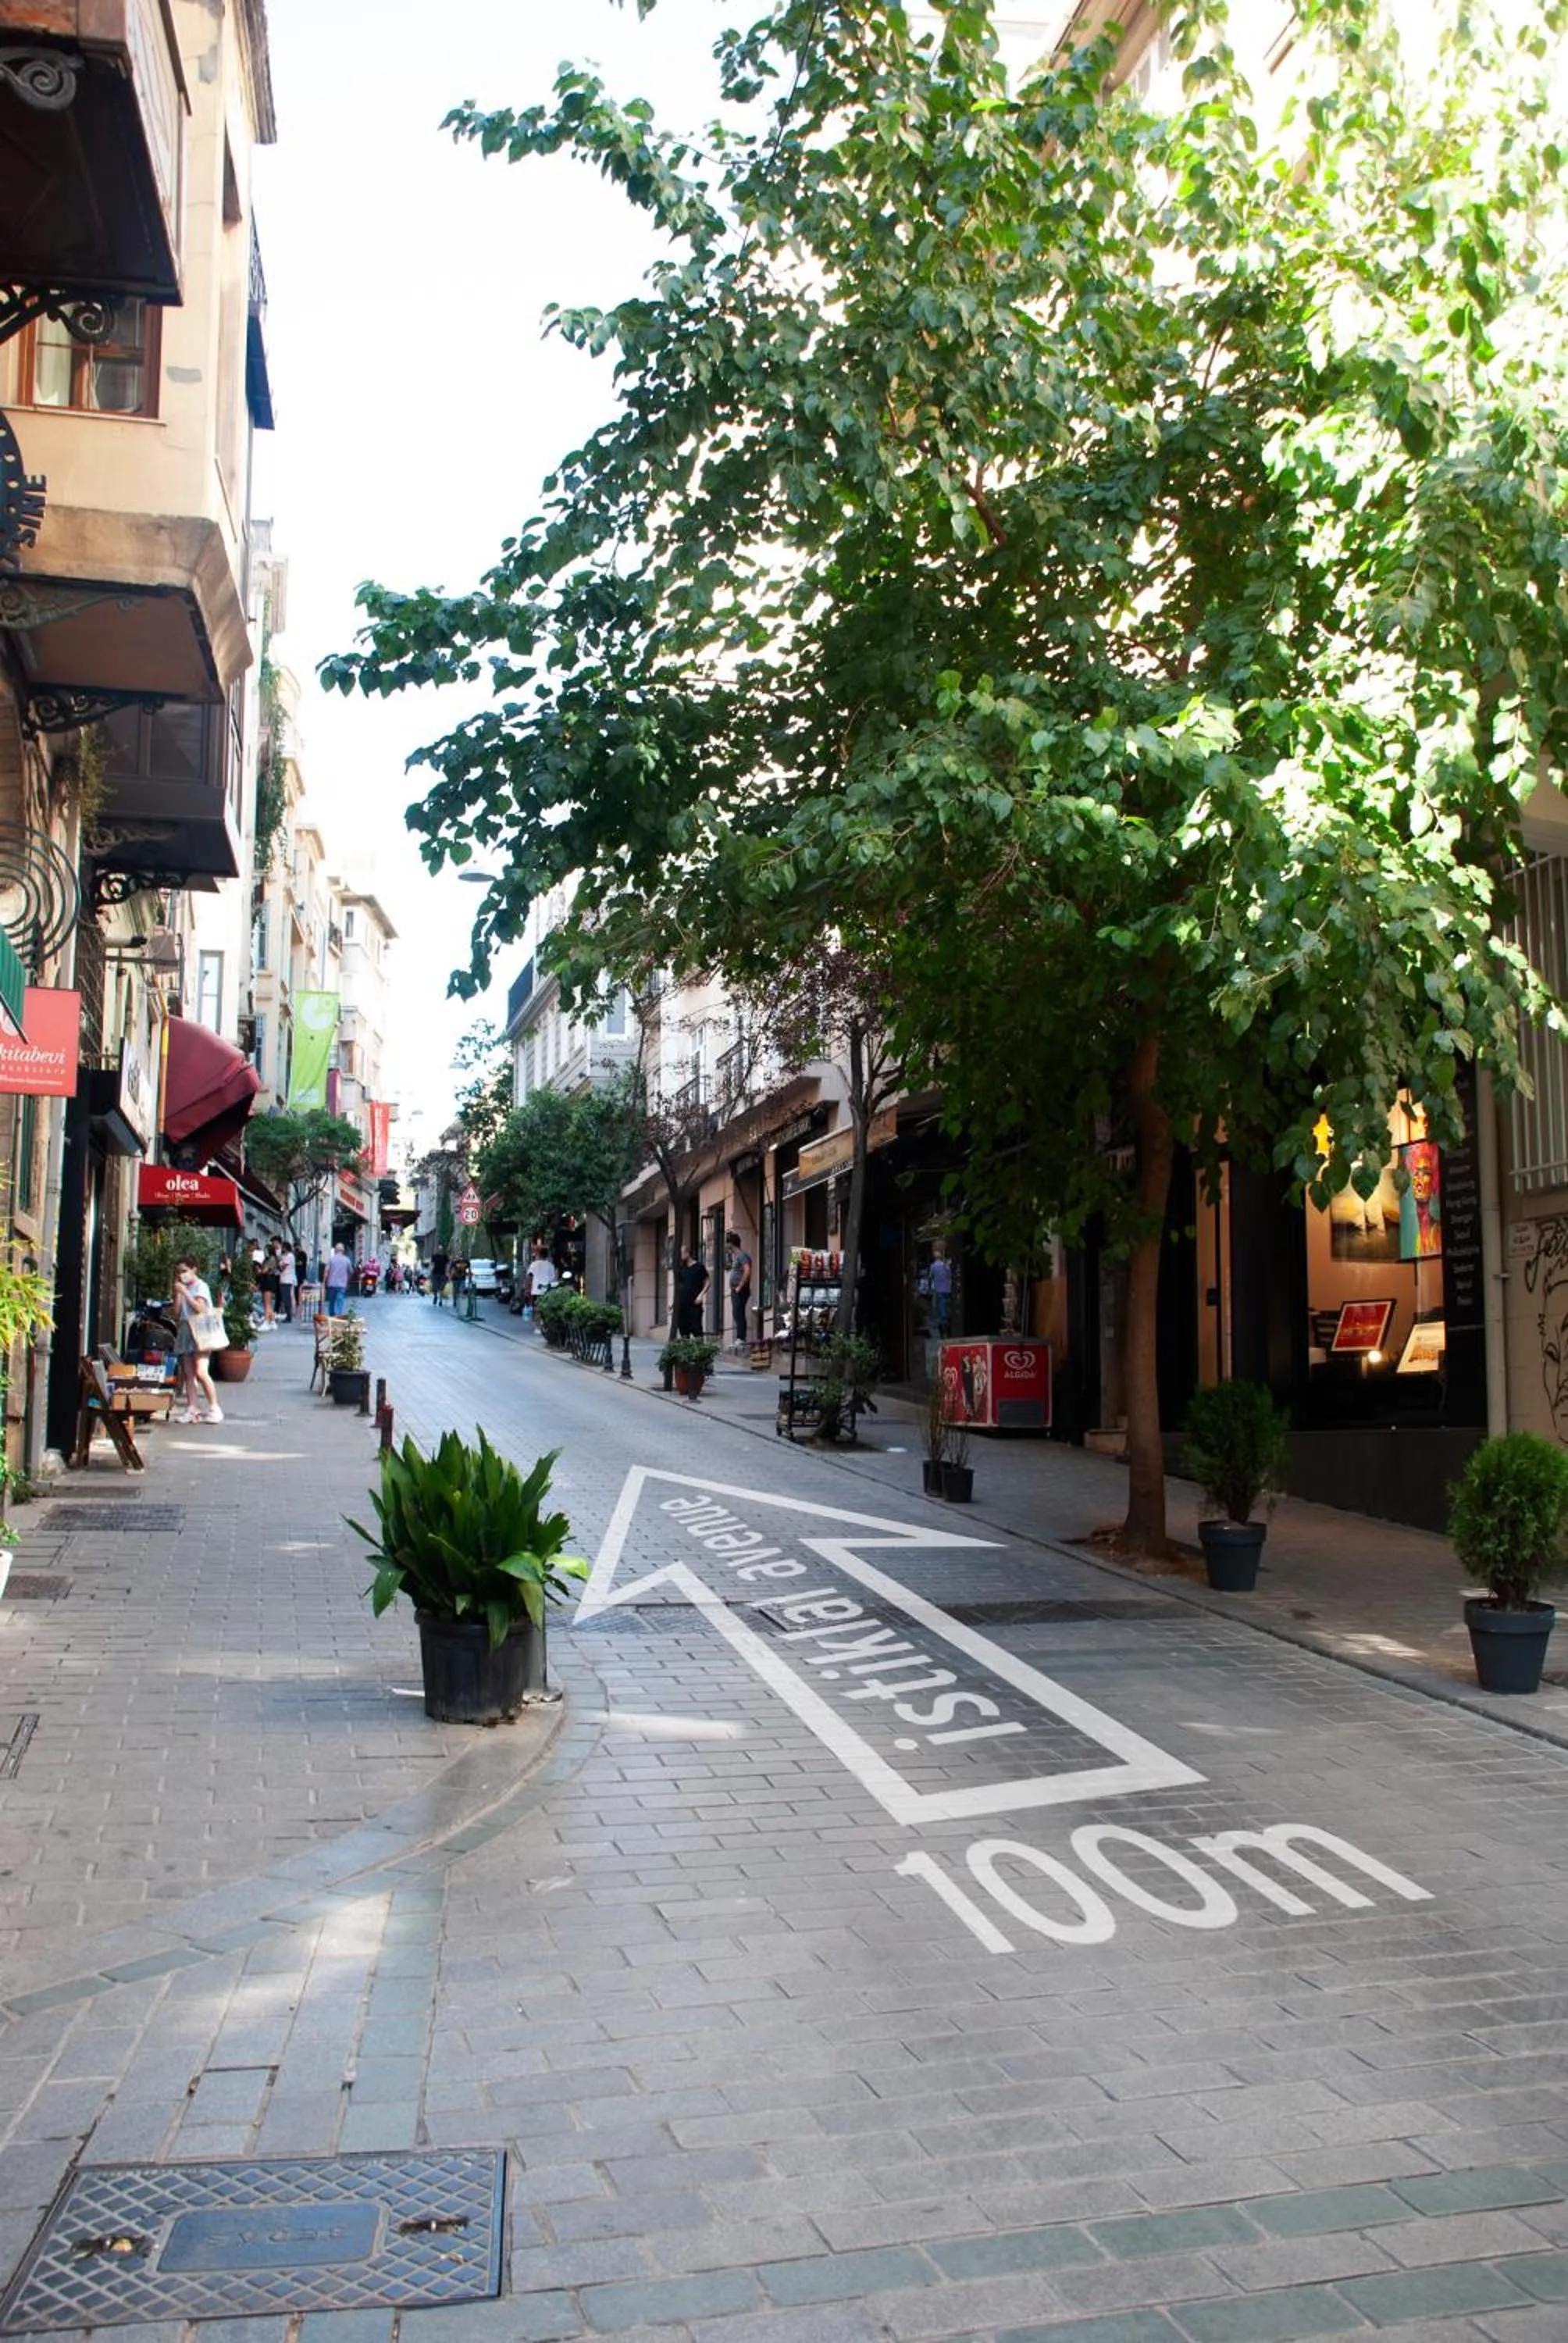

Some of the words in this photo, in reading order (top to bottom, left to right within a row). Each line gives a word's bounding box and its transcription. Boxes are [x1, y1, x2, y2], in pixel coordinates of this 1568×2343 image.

[0, 1043, 66, 1065] kitabevi
[166, 1175, 200, 1191] olea
[465, 1211, 476, 1219] 20
[659, 1495, 807, 1582] avenue
[751, 1588, 1028, 1751] istiklal
[893, 1823, 1436, 1954] 100m
